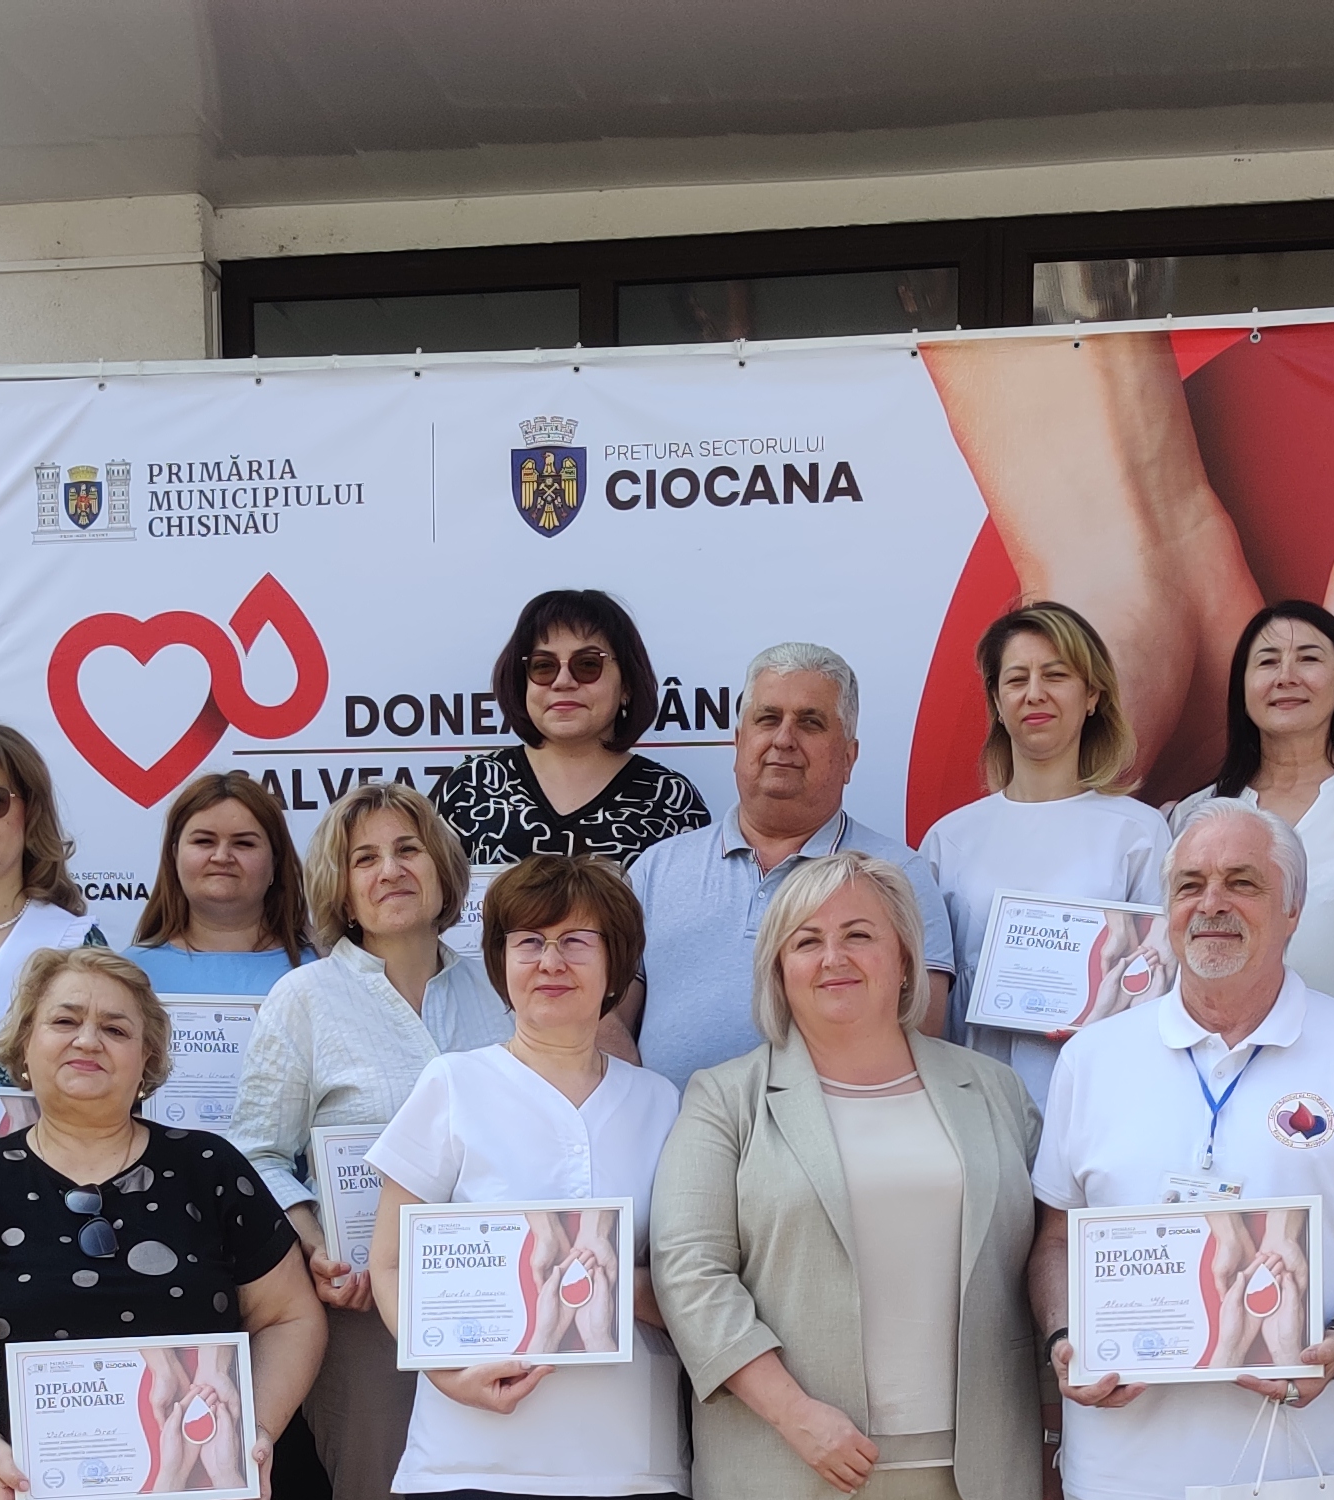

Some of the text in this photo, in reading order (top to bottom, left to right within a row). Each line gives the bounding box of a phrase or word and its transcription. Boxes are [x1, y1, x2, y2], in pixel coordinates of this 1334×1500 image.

[604, 436, 825, 461] PRETURA SECTORULUI
[147, 454, 298, 485] PRIMĂRIA
[605, 461, 864, 511] CIOCANA
[147, 482, 365, 512] MUNICIPIULUI
[345, 692, 514, 738] DONE
[81, 872, 135, 880] SECTORULUI
[75, 883, 150, 900] CANA
[1008, 924, 1069, 940] DIPLOMĂ
[1006, 934, 1081, 952] DE ONOARE
[173, 1028, 225, 1041] IPLOMĂ
[184, 1042, 239, 1053] ONOARE
[422, 1240, 492, 1256] DIPLOMĂ
[1095, 1244, 1170, 1263] DIPLOMĂ
[422, 1256, 507, 1270] DE ONOARE
[1095, 1262, 1186, 1278] DE ONOARE
[35, 1378, 108, 1396] DIPLOMĂ
[36, 1393, 125, 1409] DE ONOARE
